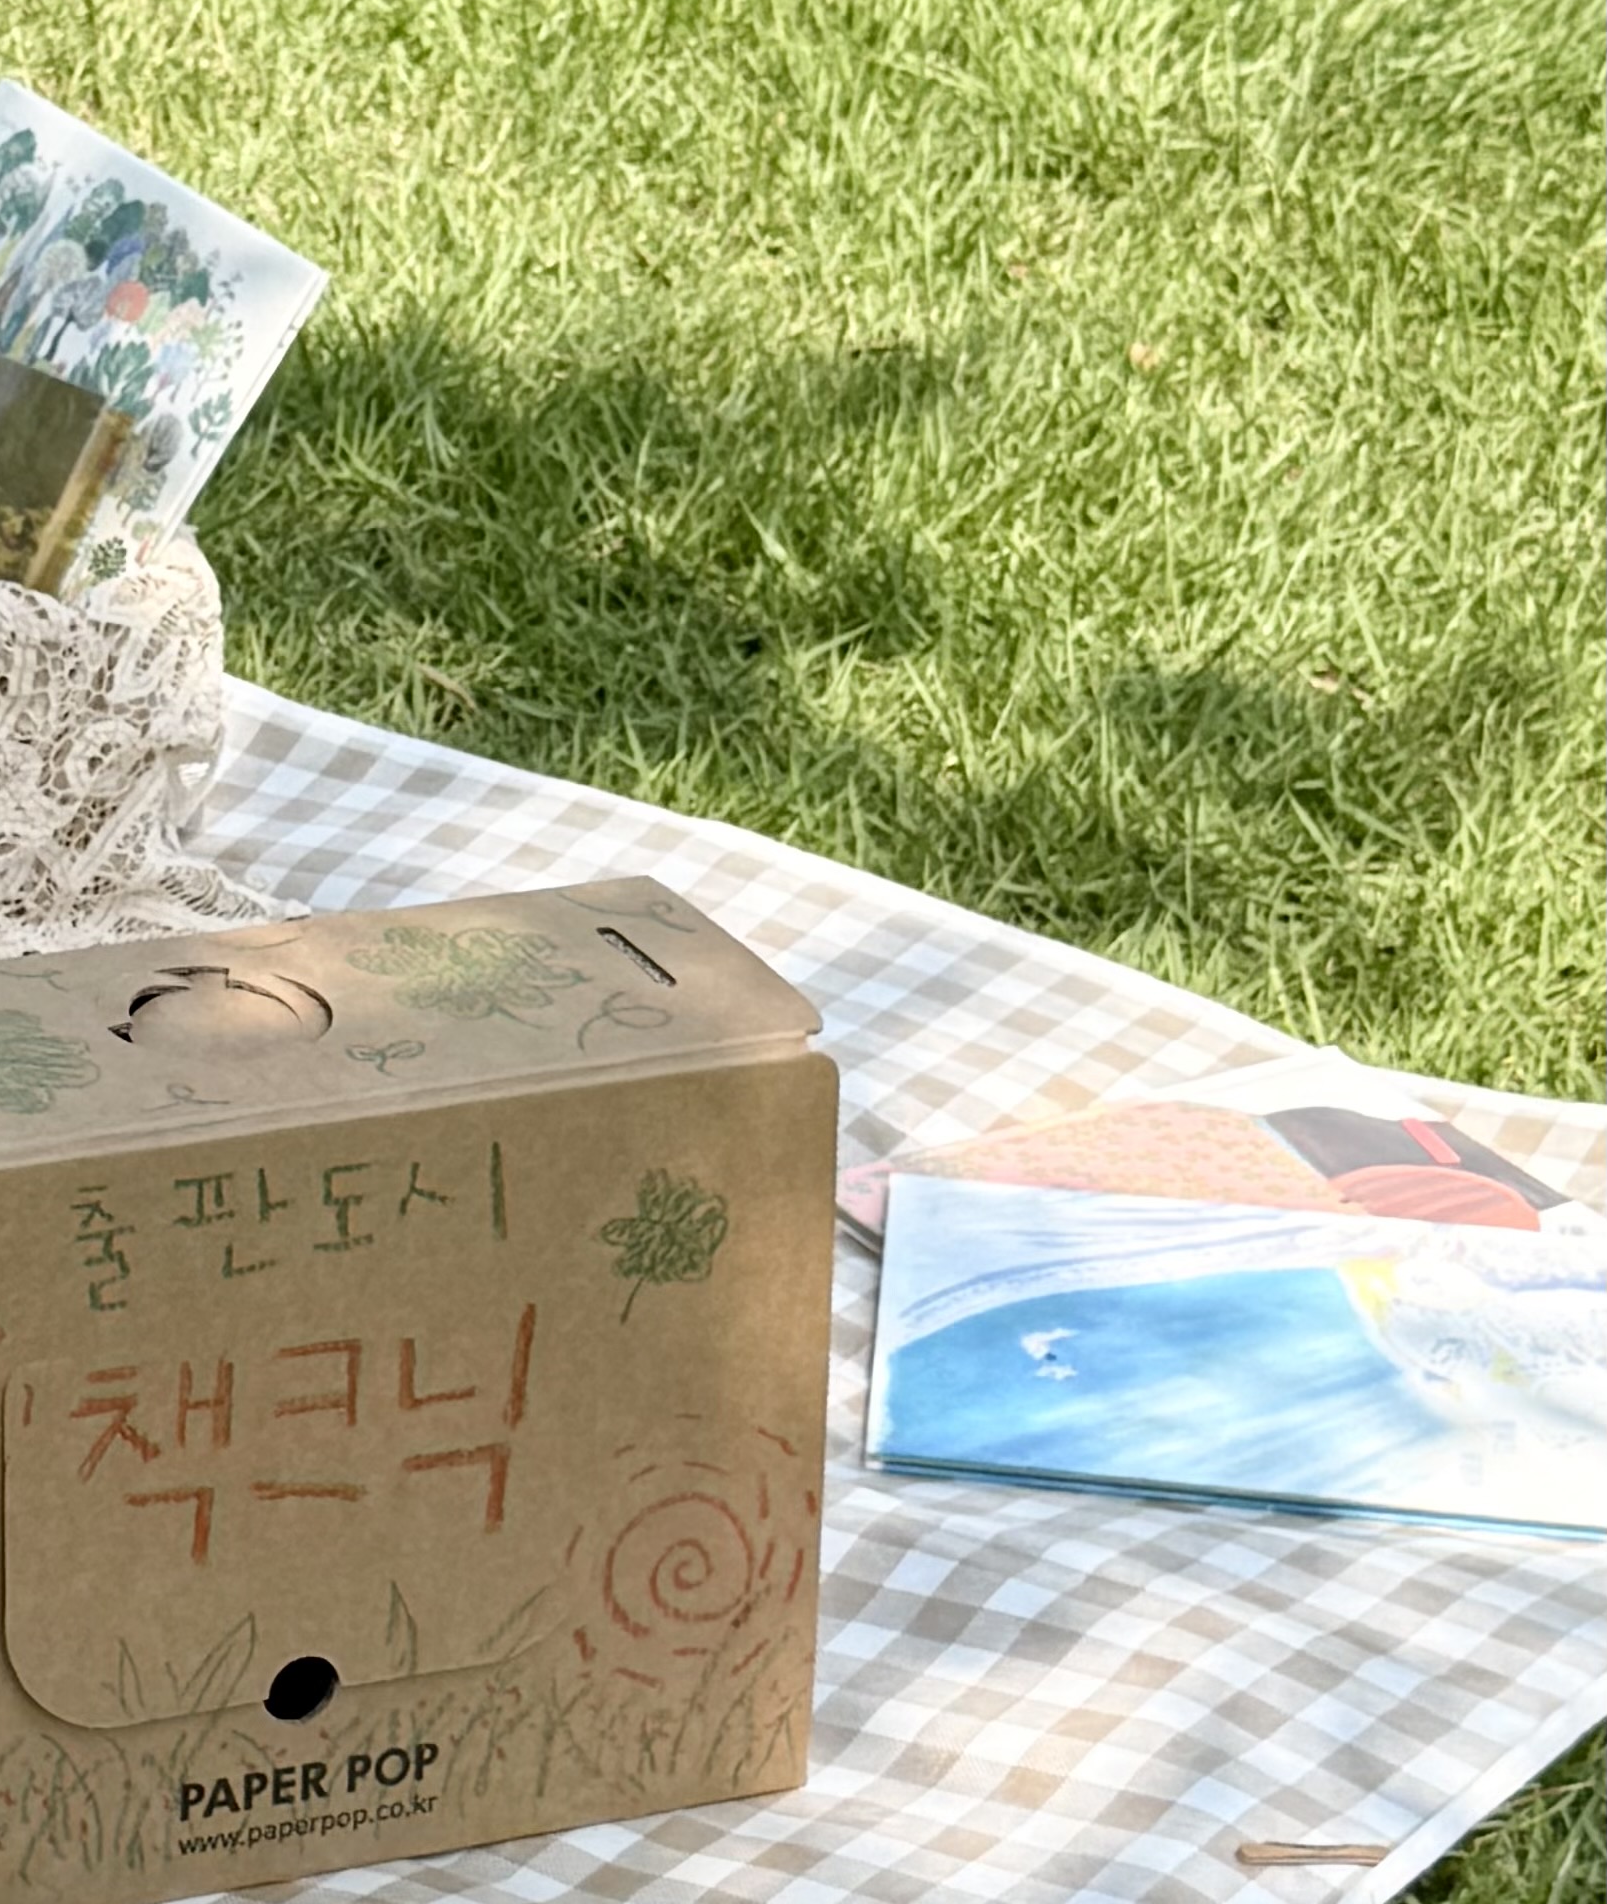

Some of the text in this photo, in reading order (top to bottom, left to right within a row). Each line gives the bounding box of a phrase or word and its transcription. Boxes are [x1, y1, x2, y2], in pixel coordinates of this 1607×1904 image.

[70, 1141, 509, 1310] 출판도시
[69, 1301, 537, 1566] 책크닉
[178, 1794, 438, 1855] www.paperpop.co.kr
[179, 1742, 440, 1822] PAPER POP
